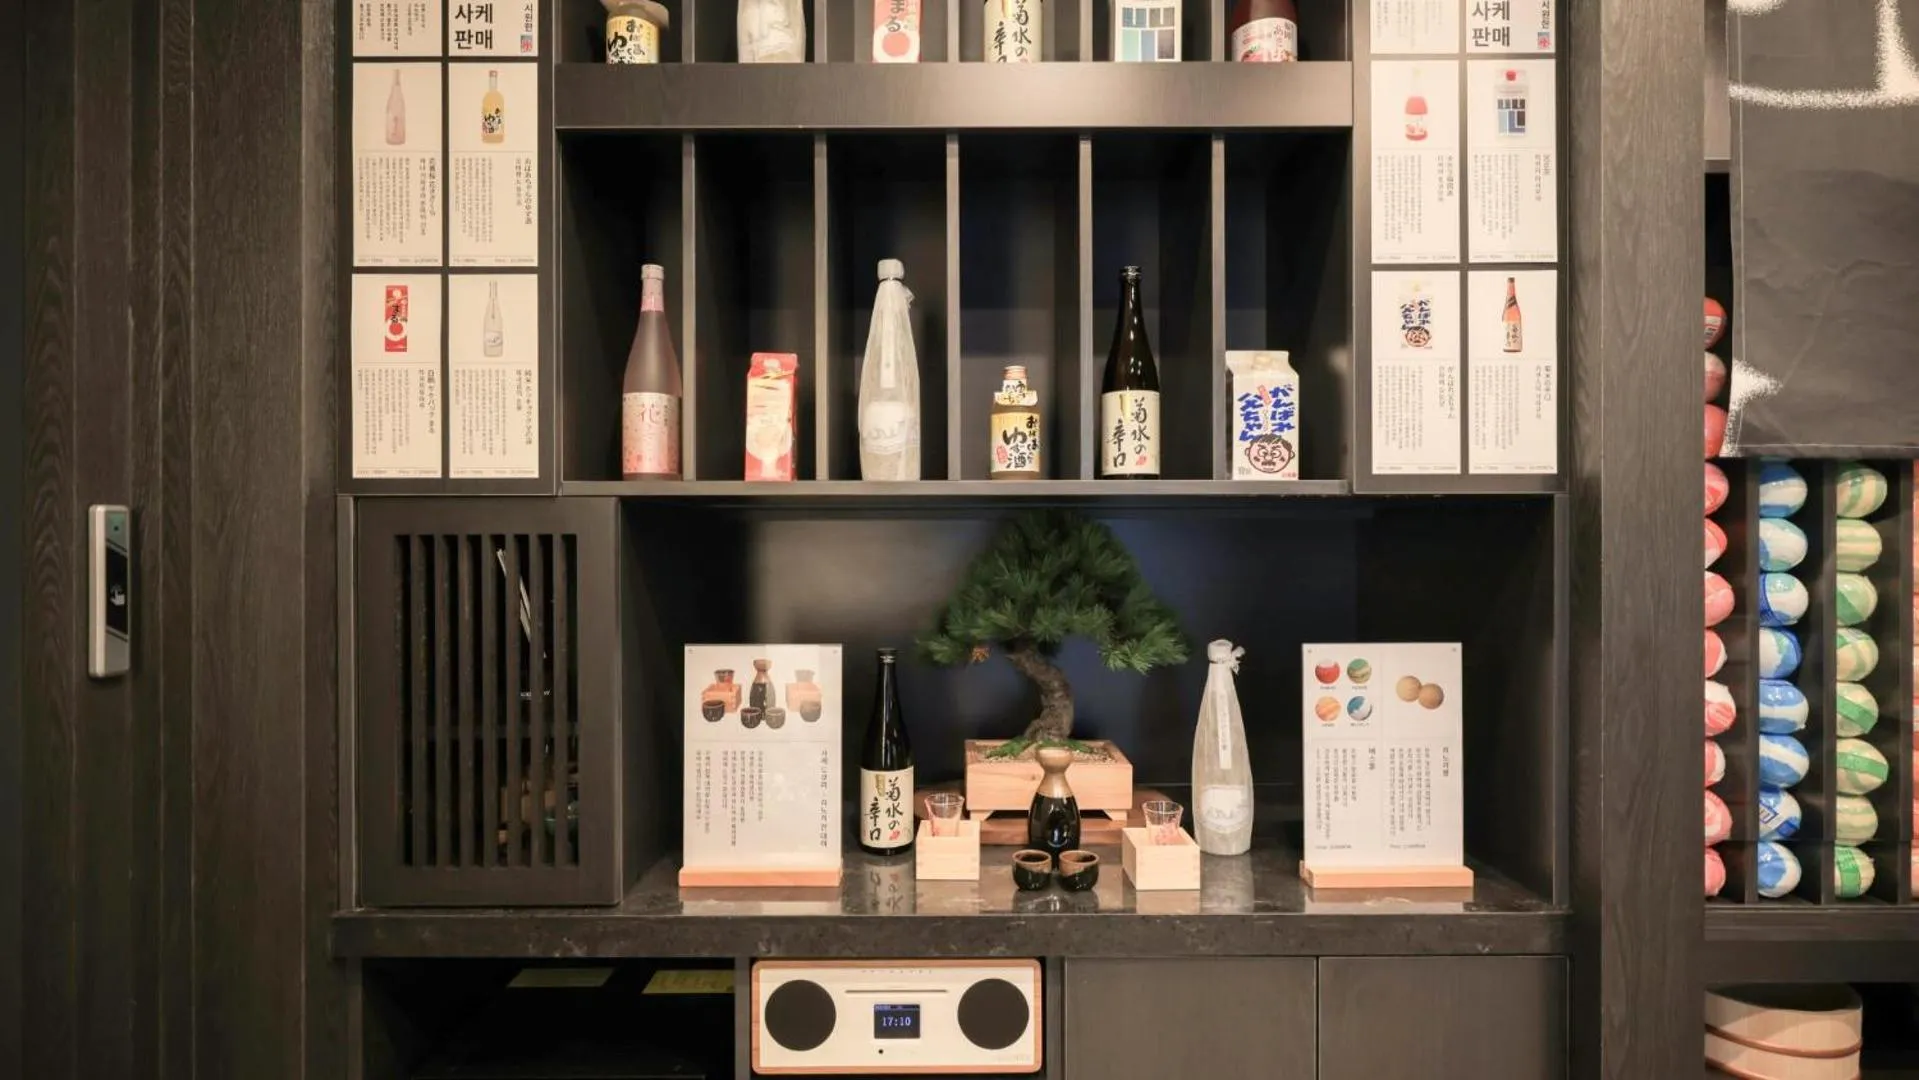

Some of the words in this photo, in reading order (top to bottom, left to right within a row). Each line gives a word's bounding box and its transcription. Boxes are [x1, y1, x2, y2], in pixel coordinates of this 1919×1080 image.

[454, 3, 493, 24] 사케
[1472, 0, 1510, 21] 사케
[454, 29, 493, 50] 판매
[1472, 26, 1510, 47] 판매
[1131, 396, 1151, 455] 菊水の
[885, 776, 904, 831] 菊水の
[882, 1016, 911, 1027] 17:10
